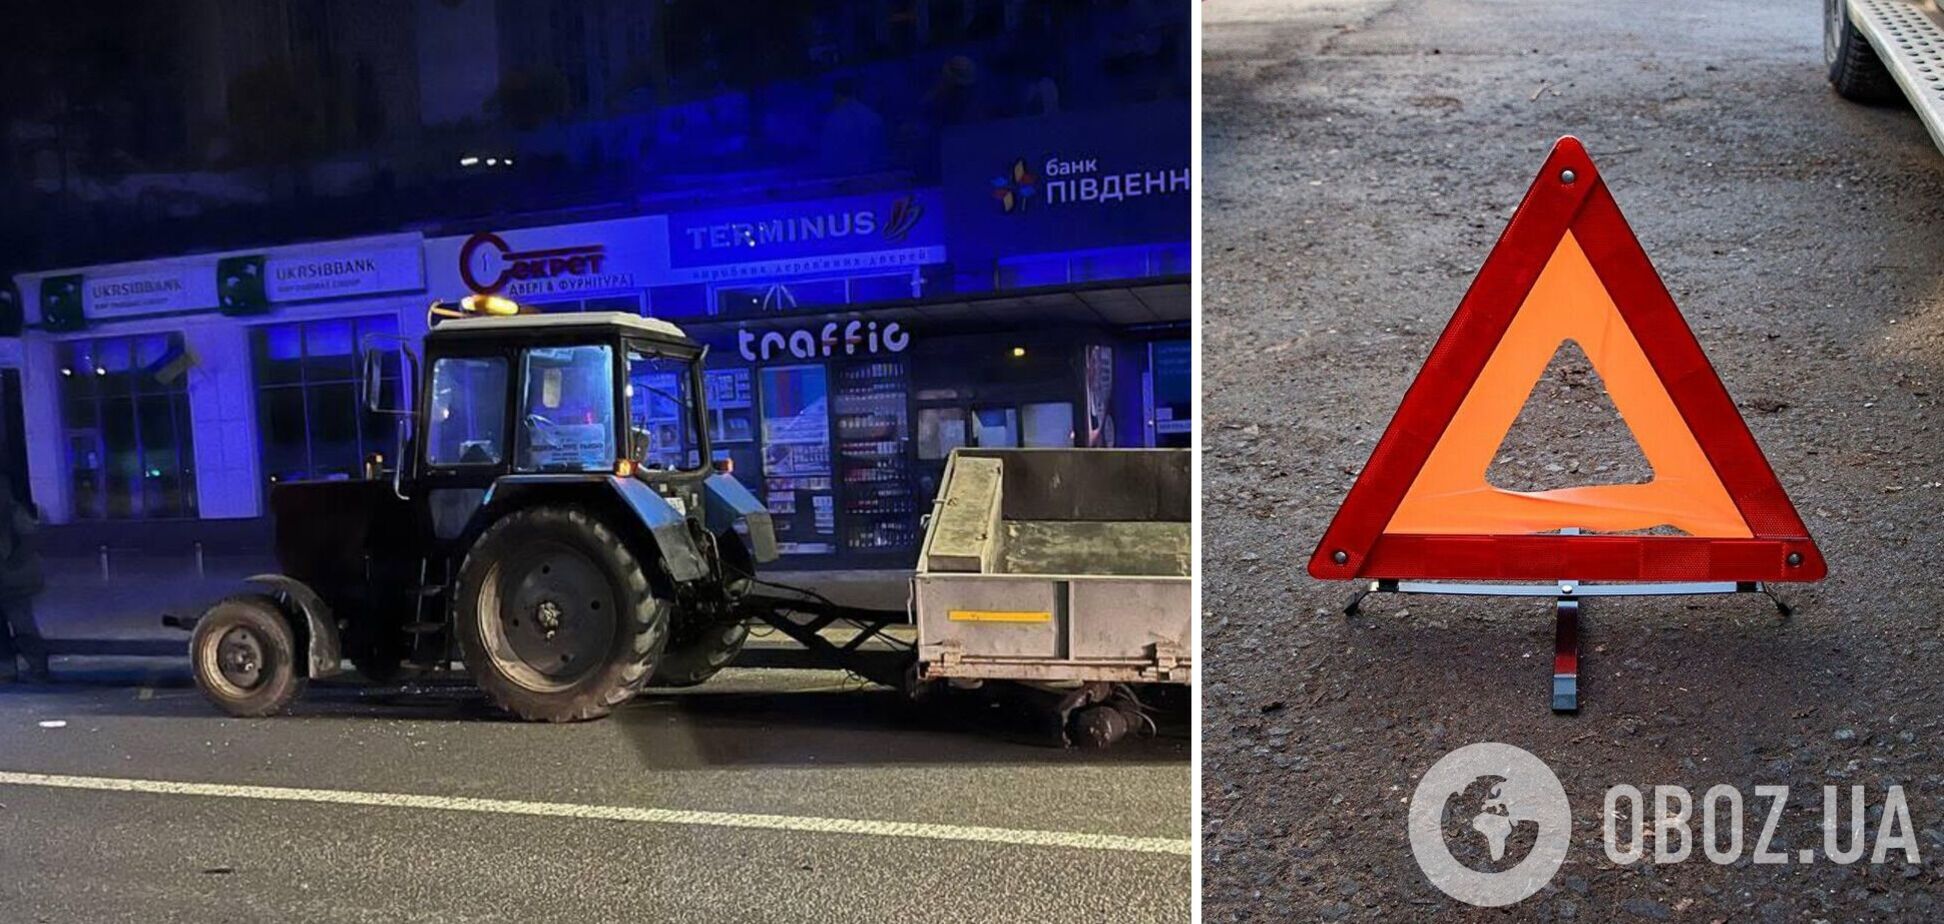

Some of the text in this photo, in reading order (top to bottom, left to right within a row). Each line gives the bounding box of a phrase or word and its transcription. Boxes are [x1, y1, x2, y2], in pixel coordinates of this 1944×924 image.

[1046, 158, 1098, 177] банк
[1046, 167, 1191, 205] ПІВДЕНН
[686, 211, 876, 250] TERMINUS
[508, 282, 542, 297] ДВЕРІ
[546, 281, 554, 291] &
[738, 320, 910, 362] traffic
